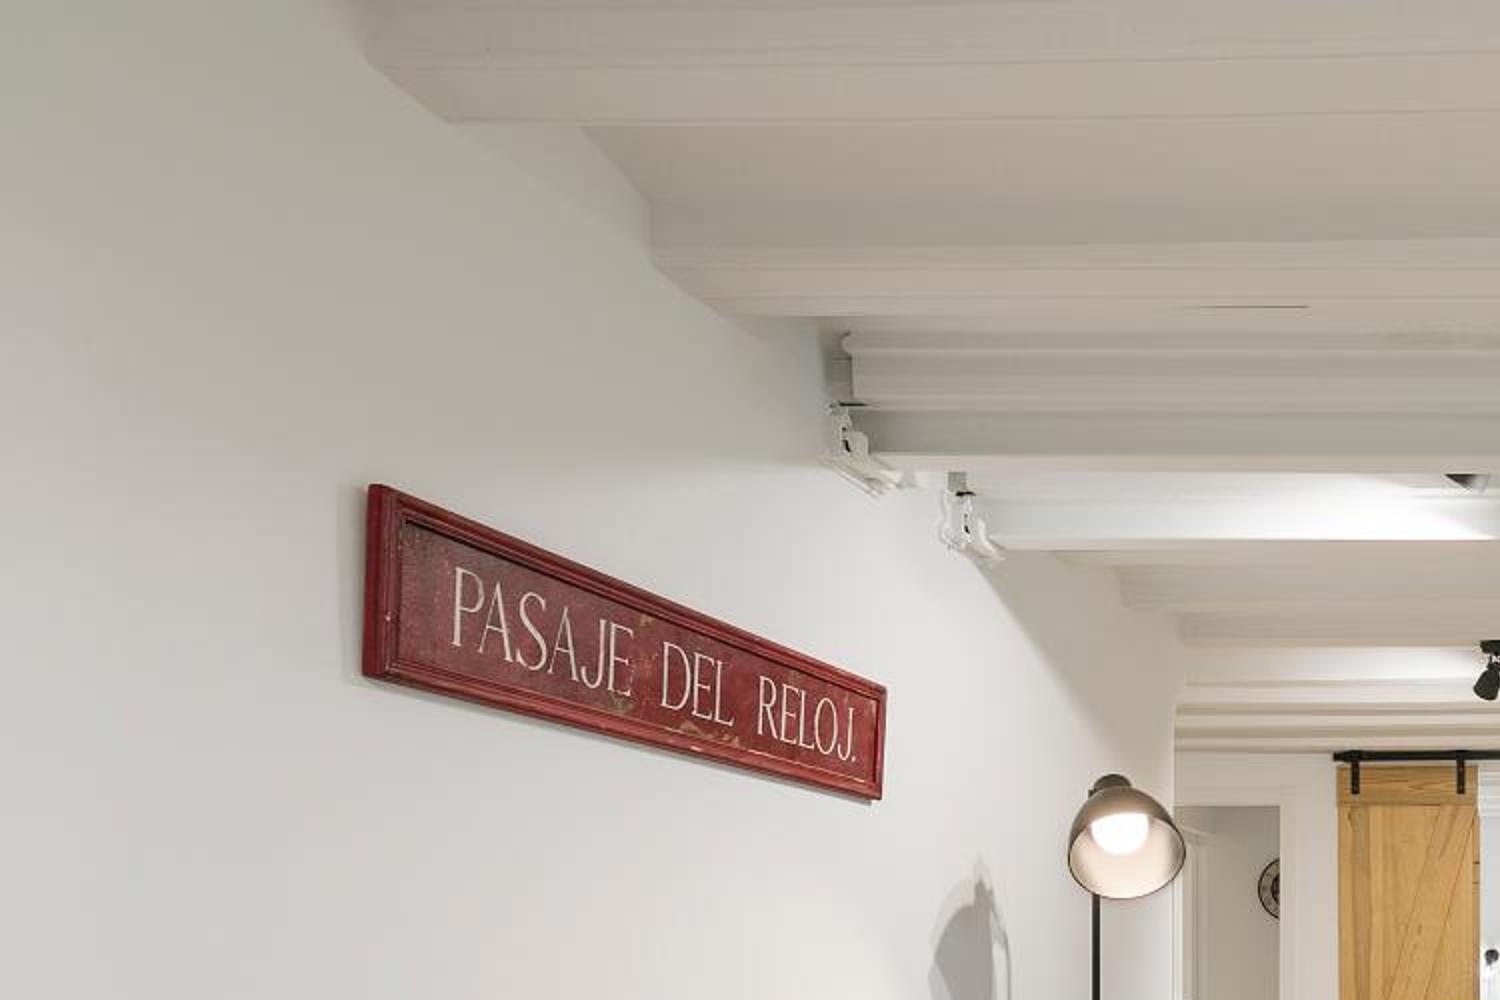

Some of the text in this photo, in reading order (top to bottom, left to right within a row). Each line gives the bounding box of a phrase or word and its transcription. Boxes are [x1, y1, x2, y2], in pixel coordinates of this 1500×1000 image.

[451, 567, 857, 763] PASAJE DEL RELOJ.
